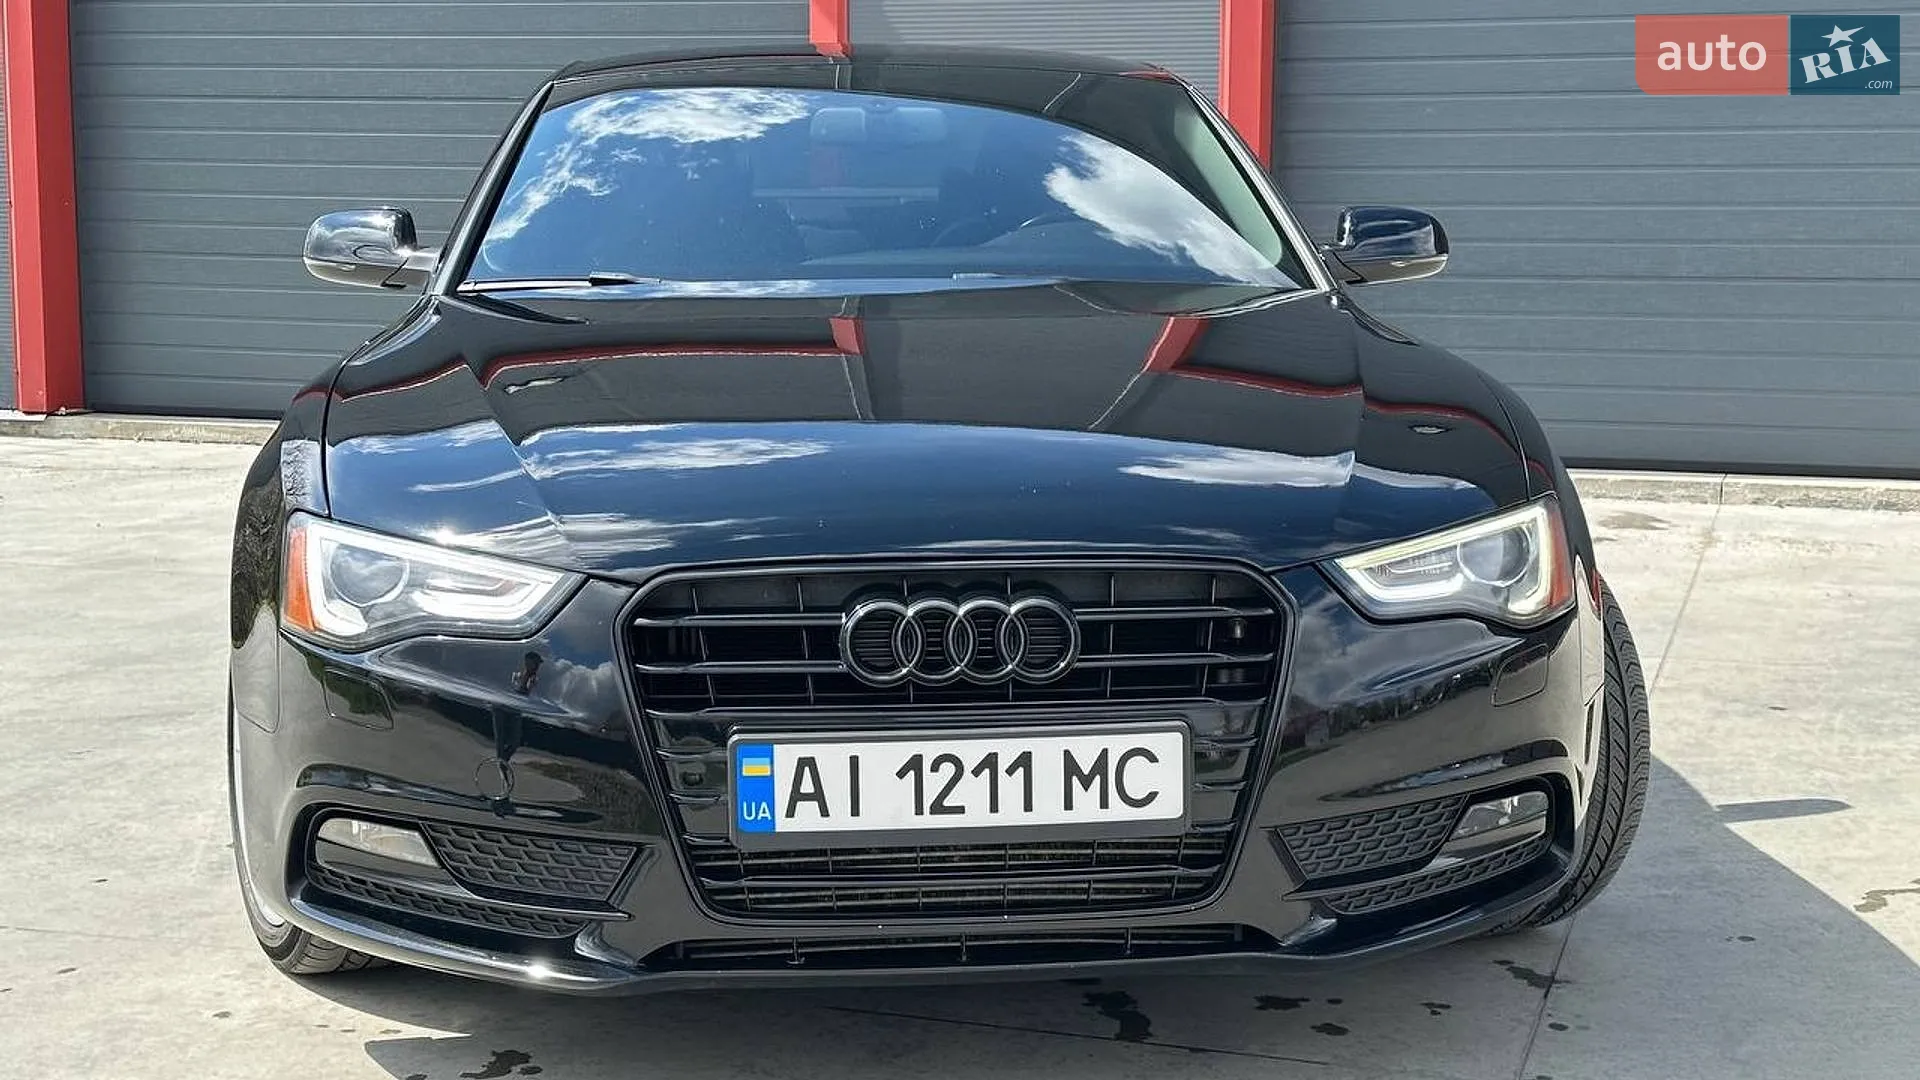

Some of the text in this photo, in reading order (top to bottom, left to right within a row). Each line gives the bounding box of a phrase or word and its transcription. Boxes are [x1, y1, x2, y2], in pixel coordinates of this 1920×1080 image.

[785, 747, 1160, 818] AI 1211 MC
[743, 801, 772, 820] UA
